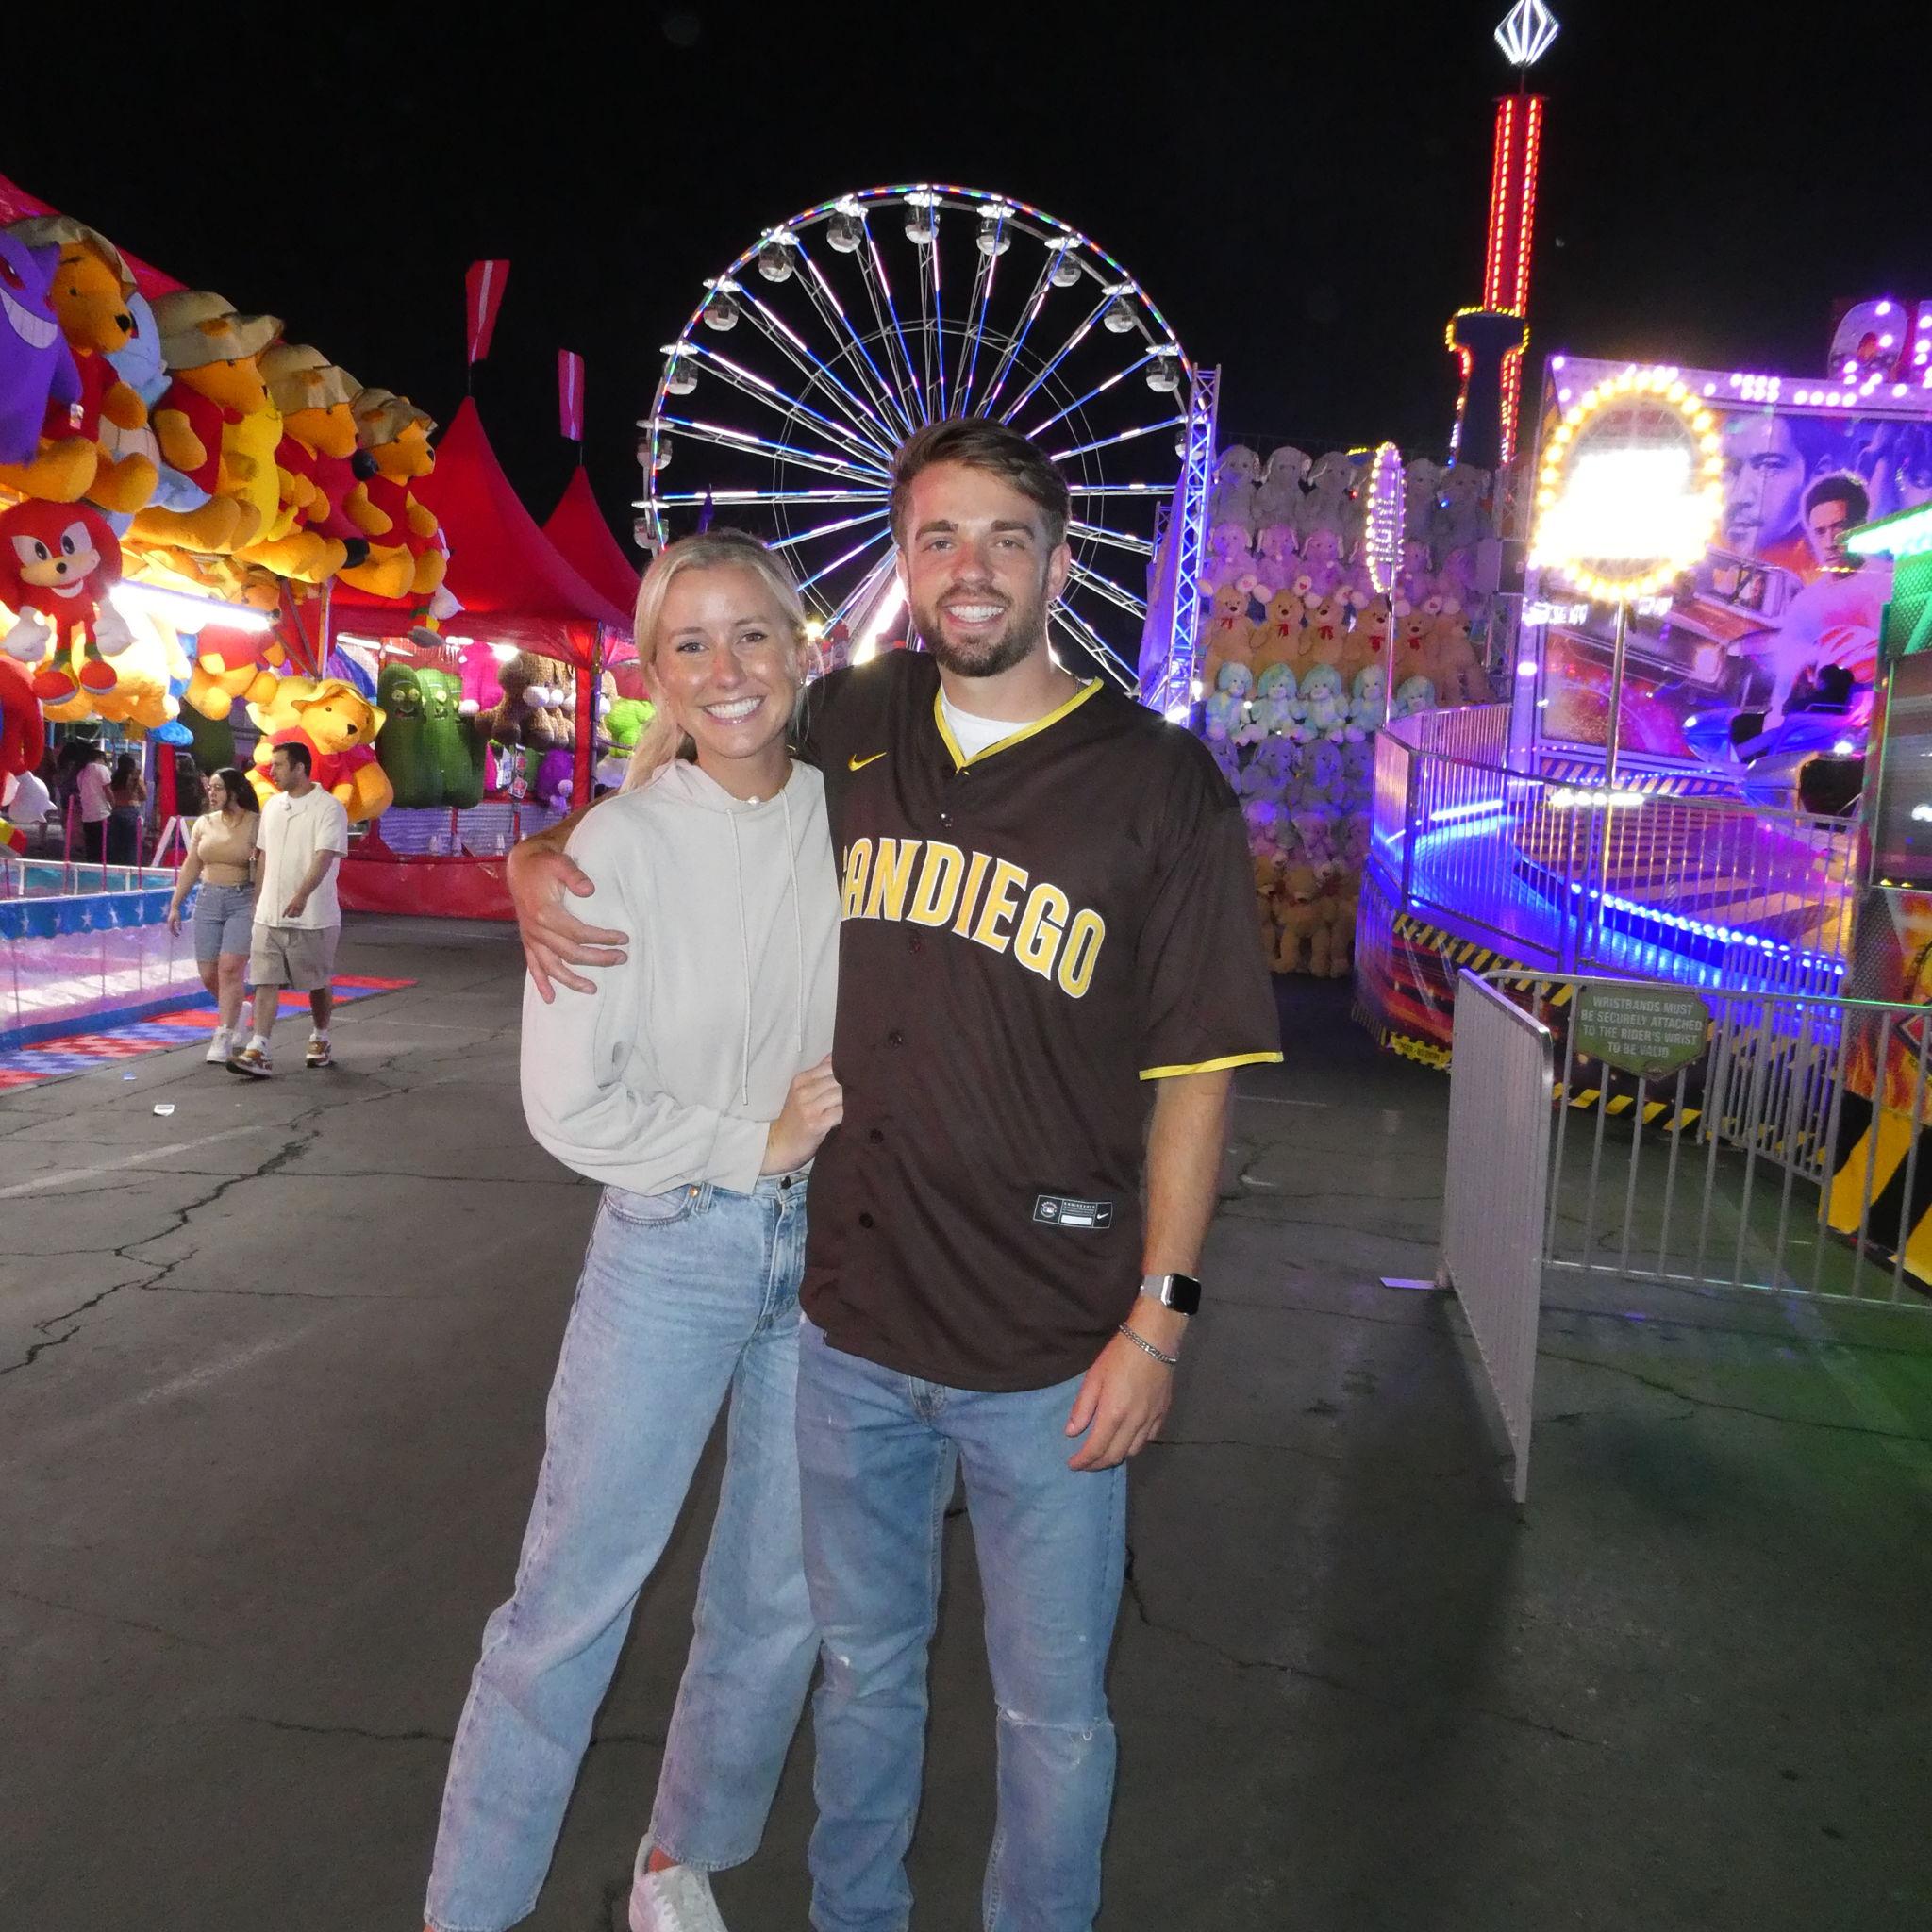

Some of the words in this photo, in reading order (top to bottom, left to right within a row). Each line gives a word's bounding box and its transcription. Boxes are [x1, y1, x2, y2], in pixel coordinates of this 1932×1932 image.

[1592, 995, 1660, 1012] WRISTBANDS
[1663, 1002, 1694, 1016] MUST
[1581, 1009, 1593, 1022] BE
[1597, 1010, 1647, 1026] SECURELY
[1651, 1016, 1703, 1031] ATTACHED
[1583, 1024, 1595, 1036] TO
[1599, 1025, 1617, 1038] THE
[1621, 1027, 1661, 1043] RIDER'S
[1665, 1032, 1698, 1045] WRIST
[1607, 1041, 1621, 1054] TO
[1624, 1042, 1636, 1055] BE
[1640, 1044, 1670, 1058] VALID
